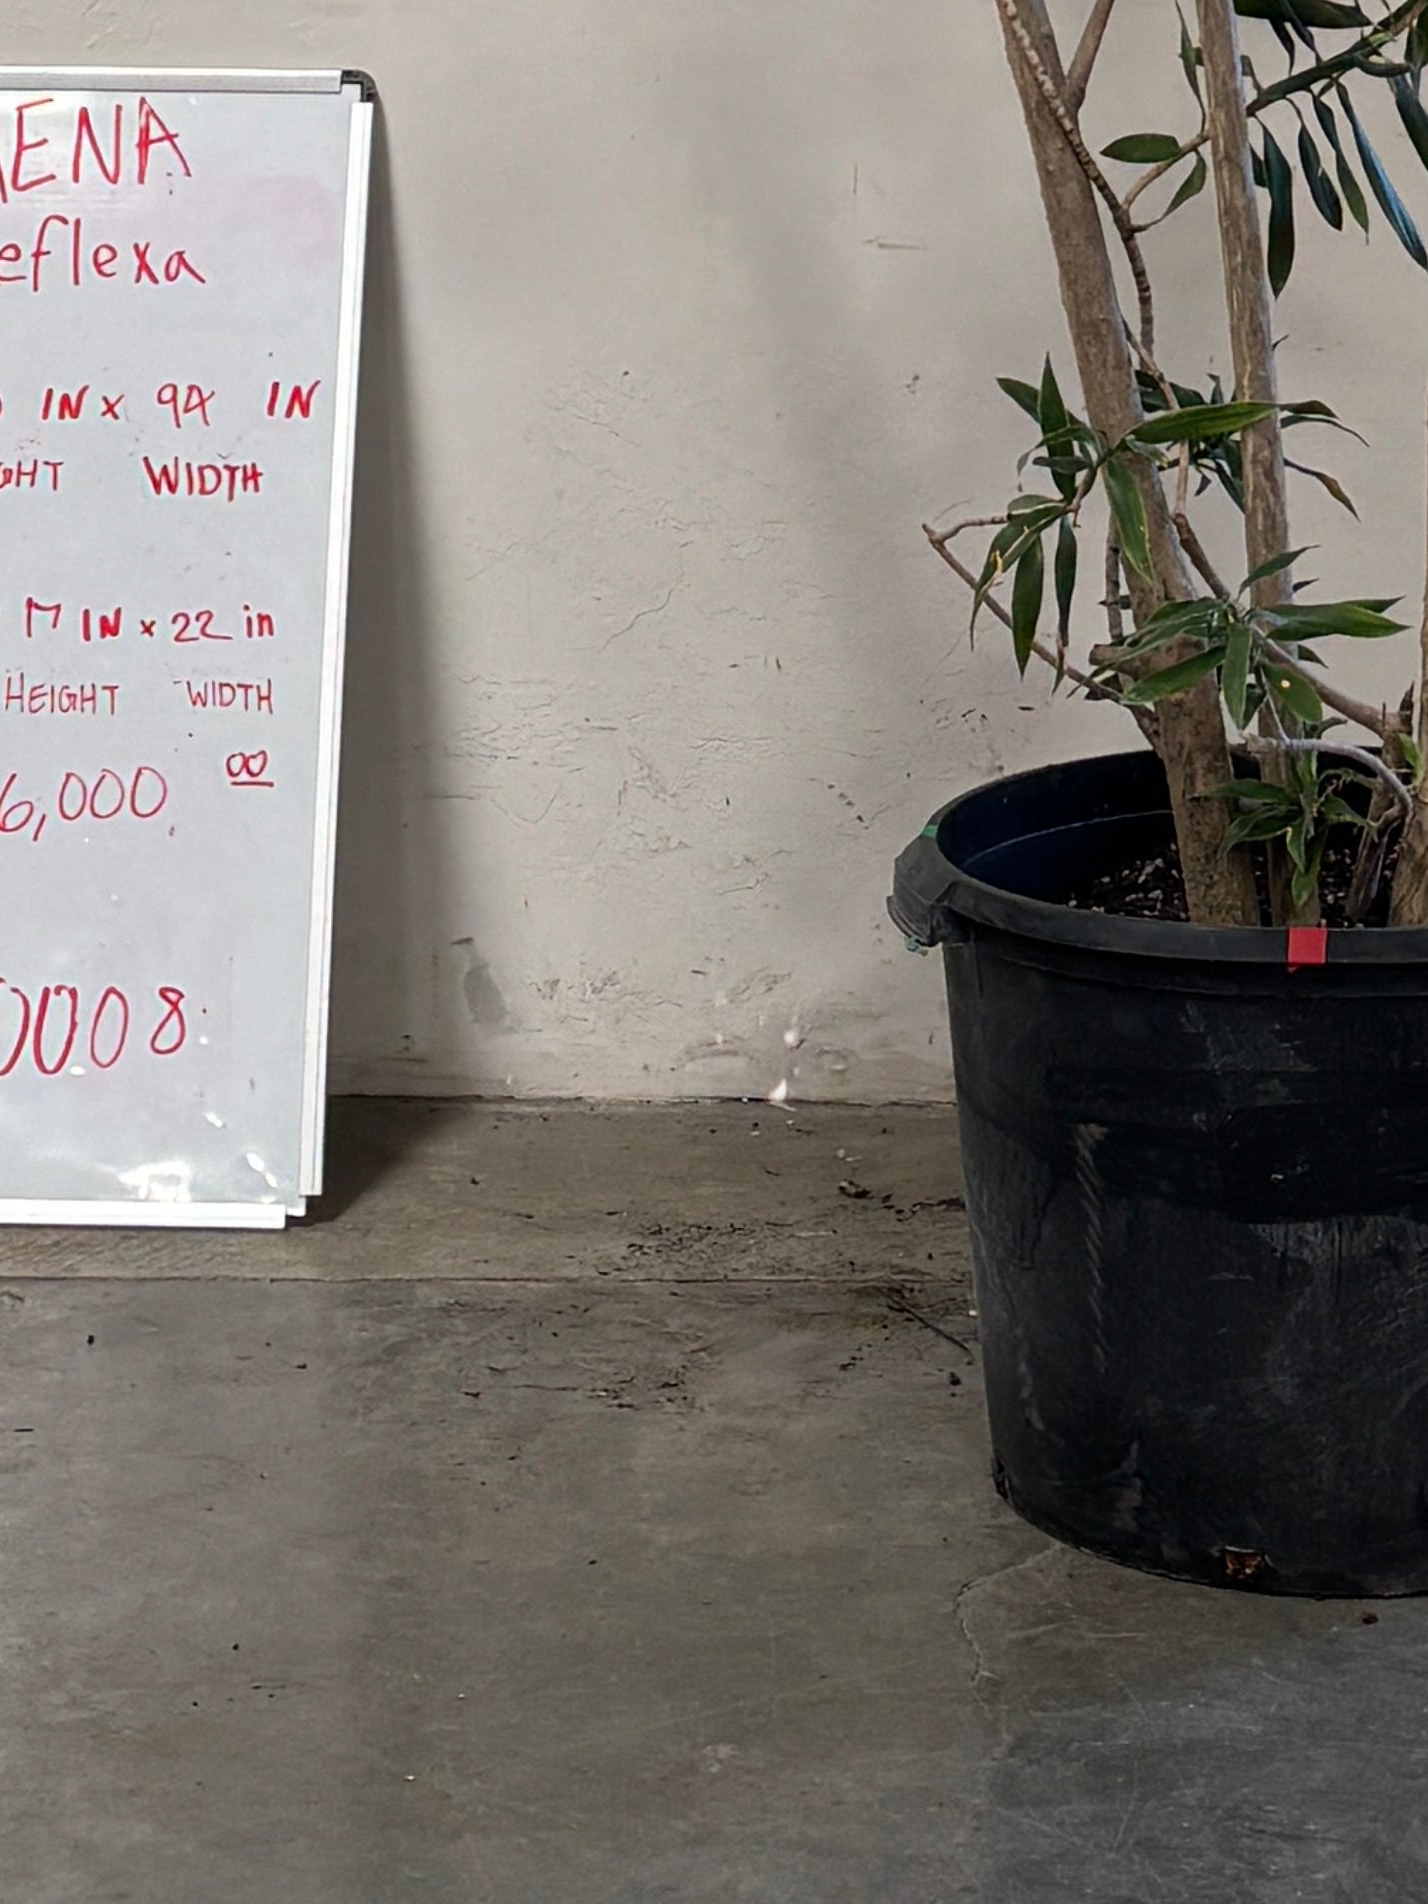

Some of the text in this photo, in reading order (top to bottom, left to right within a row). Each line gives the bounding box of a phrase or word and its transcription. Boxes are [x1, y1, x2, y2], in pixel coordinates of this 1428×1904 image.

[40, 385, 89, 423] IN
[265, 380, 319, 421] IN
[141, 457, 263, 501] WIDTH
[81, 606, 123, 642] IN
[170, 609, 229, 645] 22
[243, 603, 276, 639] in
[4, 673, 274, 715] HEIGHT WIDTH
